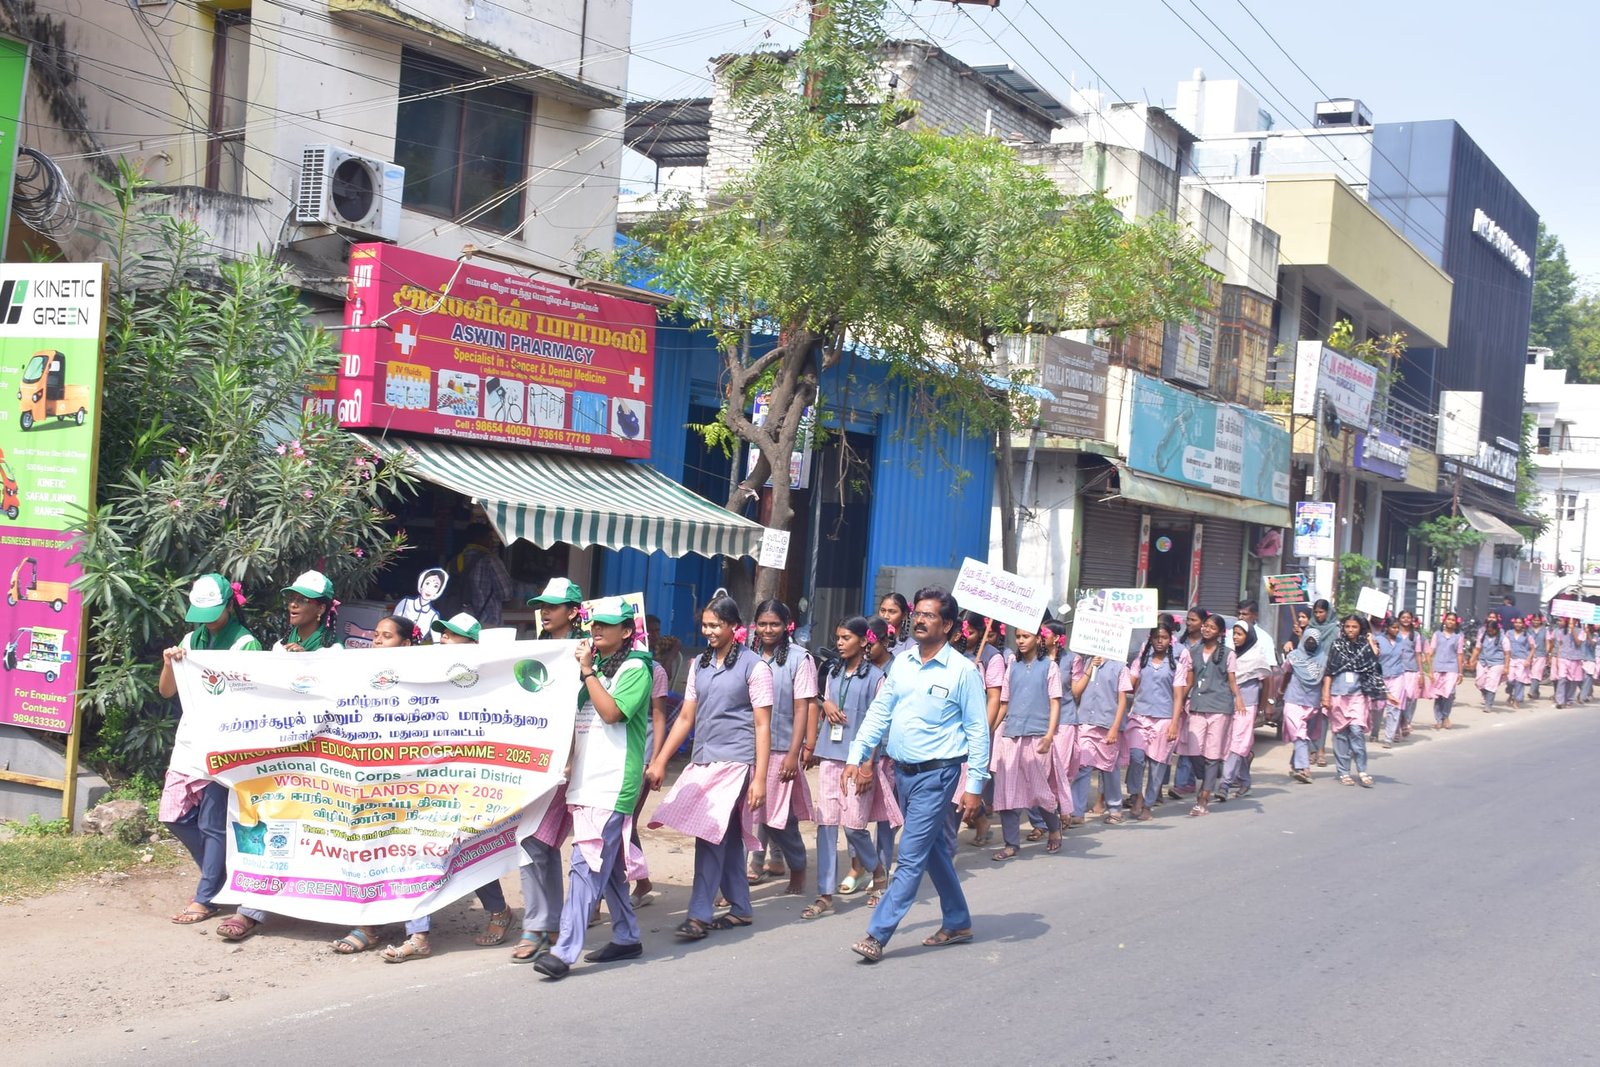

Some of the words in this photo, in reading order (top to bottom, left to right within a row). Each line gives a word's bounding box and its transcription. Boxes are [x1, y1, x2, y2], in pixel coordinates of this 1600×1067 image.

[33, 279, 95, 298] KINETIC
[33, 307, 89, 326] GREEN
[393, 283, 532, 331] அஸ்வின்
[536, 313, 648, 355] பார்மஸி
[452, 323, 506, 350] ASWIN
[510, 334, 596, 364] PHARMACY
[454, 347, 495, 366] Specialist
[496, 354, 505, 364] in
[510, 357, 538, 373] Cancer
[540, 363, 546, 375] &
[549, 364, 572, 379] Dental
[574, 368, 607, 384] Medicine
[455, 419, 470, 430] Cell
[475, 420, 504, 434] 98654
[505, 423, 532, 437] 40050
[538, 428, 564, 441] 93616
[565, 431, 592, 444] 77719
[1111, 591, 1144, 603] Stop
[1111, 602, 1153, 613] Waste
[346, 639, 374, 649] MEDICA
[14, 687, 29, 699] For
[30, 689, 67, 704] Enquires
[336, 694, 400, 709] தமிழ்நாடு
[408, 695, 440, 705] அரசு
[22, 701, 59, 715] Contact:
[13, 713, 66, 729] 9894333320
[313, 708, 363, 725] மற்றும்
[373, 708, 449, 723] காலநிலை
[459, 708, 549, 729] மாற்றத்துறை
[389, 729, 429, 739] மதுரை
[433, 727, 486, 738] மாவட்டம்
[209, 740, 317, 769] ENVIRONMENT
[321, 741, 394, 761] EDUCATION
[399, 744, 496, 760] PROGRAMME
[505, 747, 531, 764] 2025
[538, 752, 550, 767] 26
[256, 761, 317, 775] National
[320, 762, 352, 780] Green
[354, 770, 401, 784] Corps
[416, 765, 477, 779] Madurai
[480, 767, 523, 785] District
[274, 775, 331, 791] WORLD
[333, 783, 419, 799] WETLANDS
[425, 783, 460, 796] DAY
[472, 785, 503, 801] 2026
[417, 796, 461, 809] தினம்
[303, 823, 326, 835] Theme
[362, 831, 377, 841] and
[271, 878, 287, 892] By
[296, 880, 342, 896] GREEN
[345, 884, 386, 899] TRUST,
